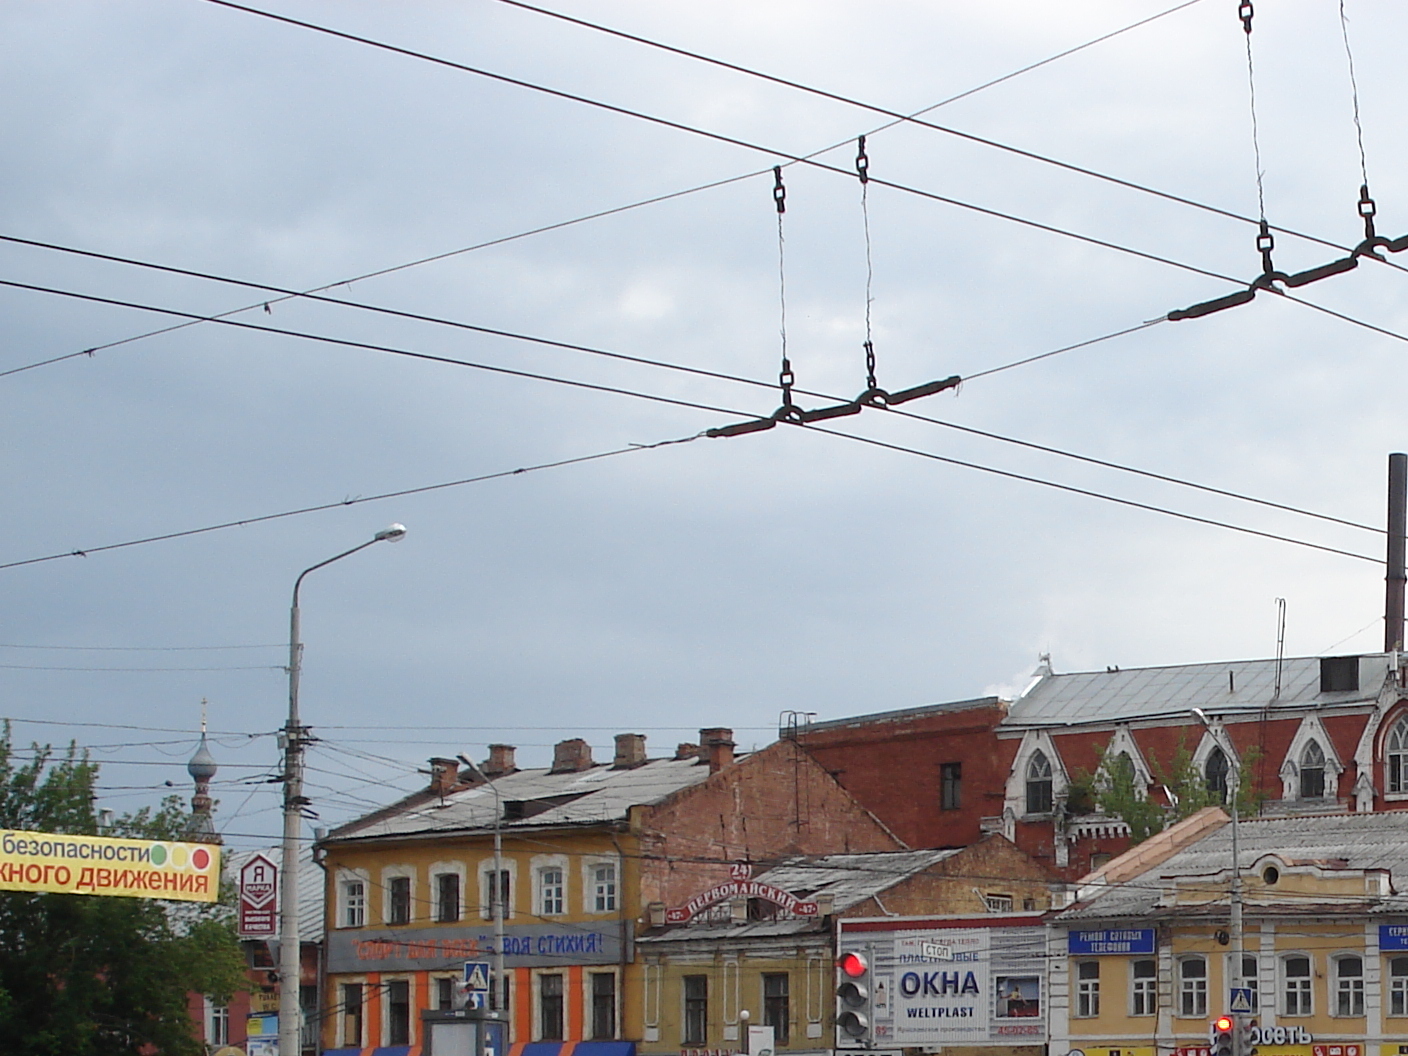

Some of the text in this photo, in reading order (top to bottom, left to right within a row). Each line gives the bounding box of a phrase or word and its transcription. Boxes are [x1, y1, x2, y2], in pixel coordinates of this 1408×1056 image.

[2, 834, 150, 863] безопасности
[76, 867, 209, 893] движения
[732, 864, 748, 876] 24
[538, 933, 603, 955] СТИХИЯ!
[926, 945, 949, 957] СТОП
[901, 971, 980, 996] ОКНА
[907, 1007, 974, 1018] WELTPLAST
